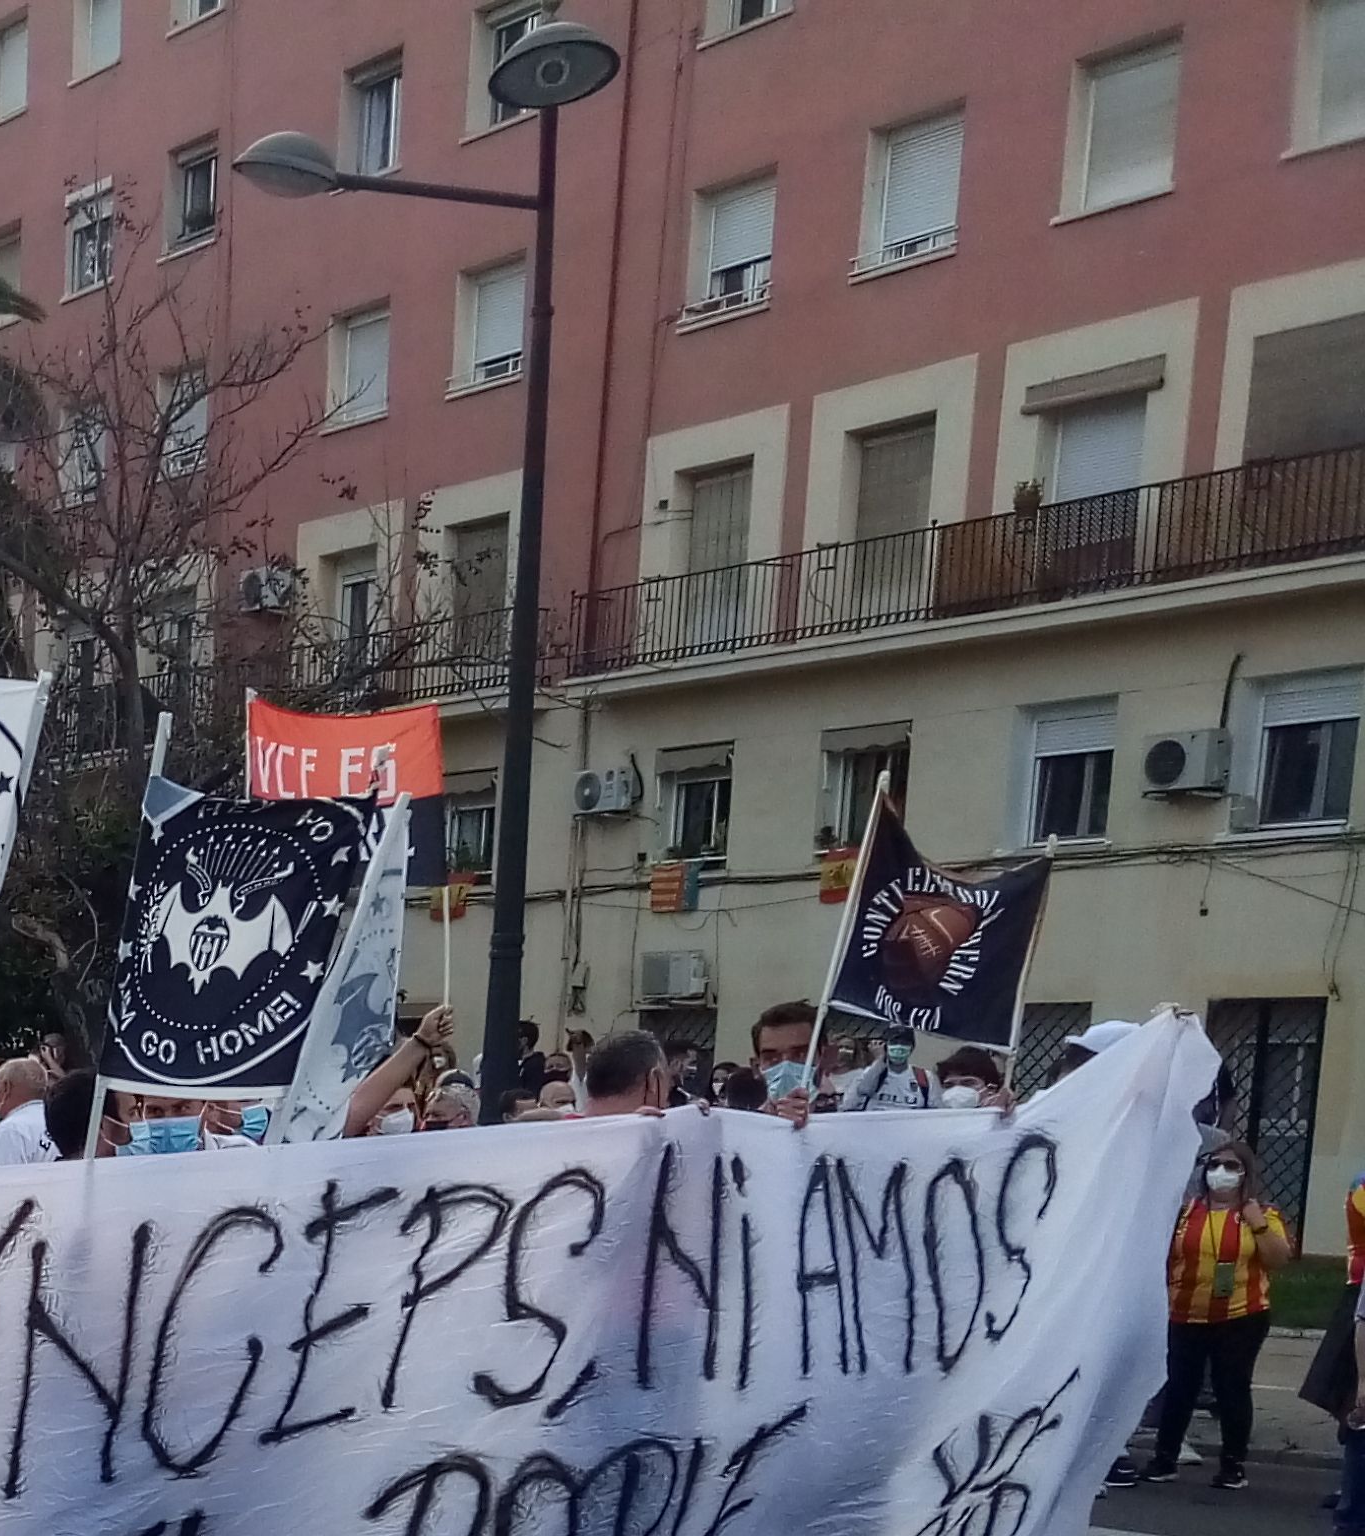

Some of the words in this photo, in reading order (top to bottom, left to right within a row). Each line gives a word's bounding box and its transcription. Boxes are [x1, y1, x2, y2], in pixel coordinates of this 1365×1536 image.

[256, 736, 318, 799] VCF
[140, 1030, 177, 1064] GO
[196, 990, 303, 1064] HOME!
[797, 1131, 1057, 1377] AMOS
